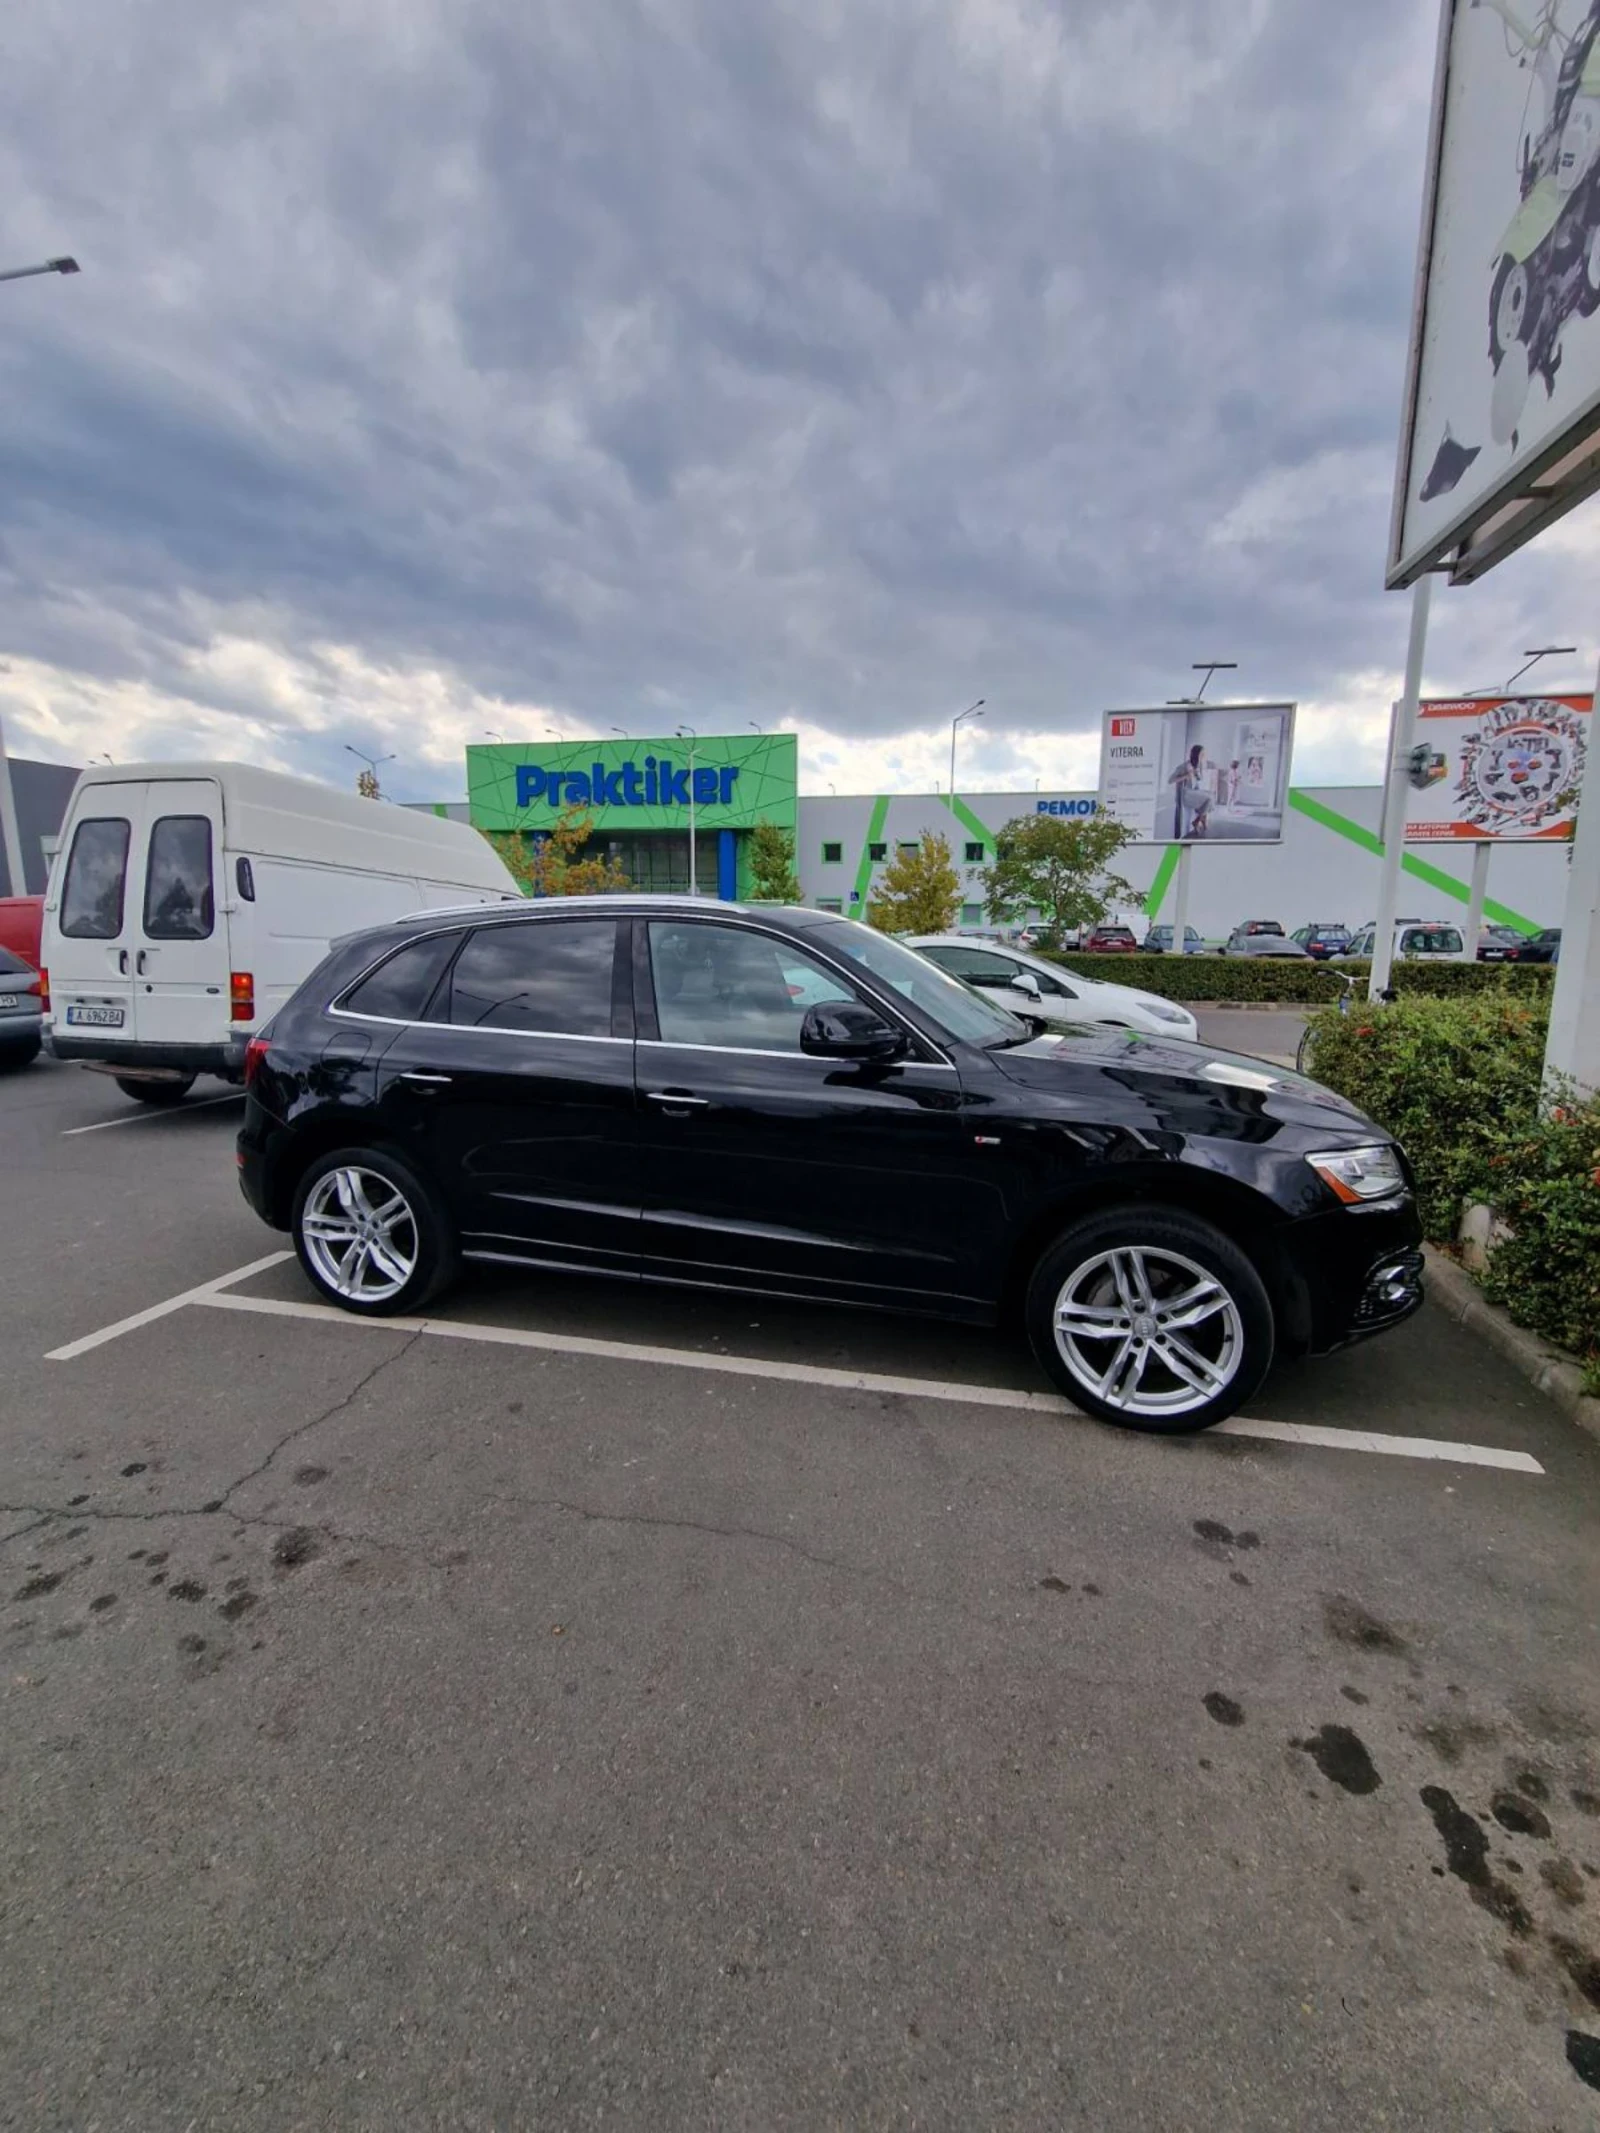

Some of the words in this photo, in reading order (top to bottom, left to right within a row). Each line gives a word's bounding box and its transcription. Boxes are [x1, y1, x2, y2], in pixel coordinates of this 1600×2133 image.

[1428, 702, 1476, 711] DAEWOO
[1110, 746, 1144, 758] VITERRA
[516, 755, 739, 807] Praktiker
